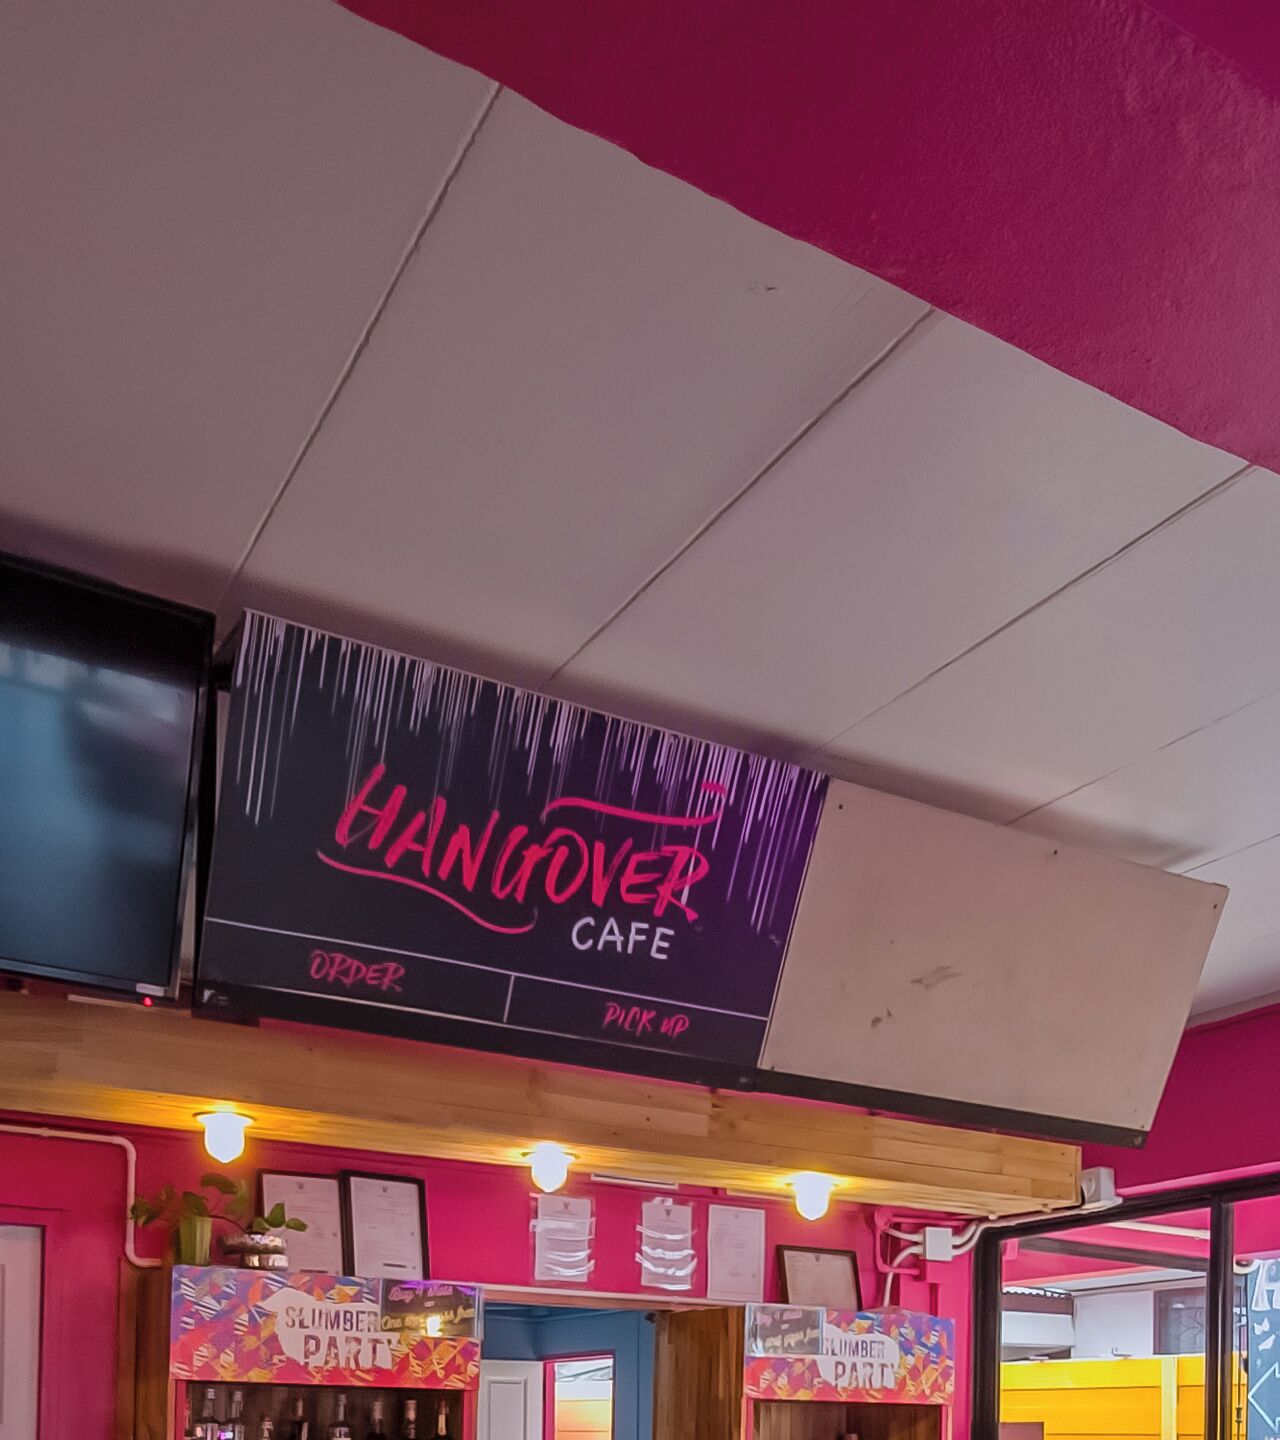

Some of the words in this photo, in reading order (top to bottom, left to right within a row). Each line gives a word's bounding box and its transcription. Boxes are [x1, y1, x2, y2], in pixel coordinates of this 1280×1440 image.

[335, 763, 711, 924] HANGOVER
[572, 916, 676, 961] CAFE
[309, 950, 407, 994] ORDER
[603, 1001, 654, 1035] PICK
